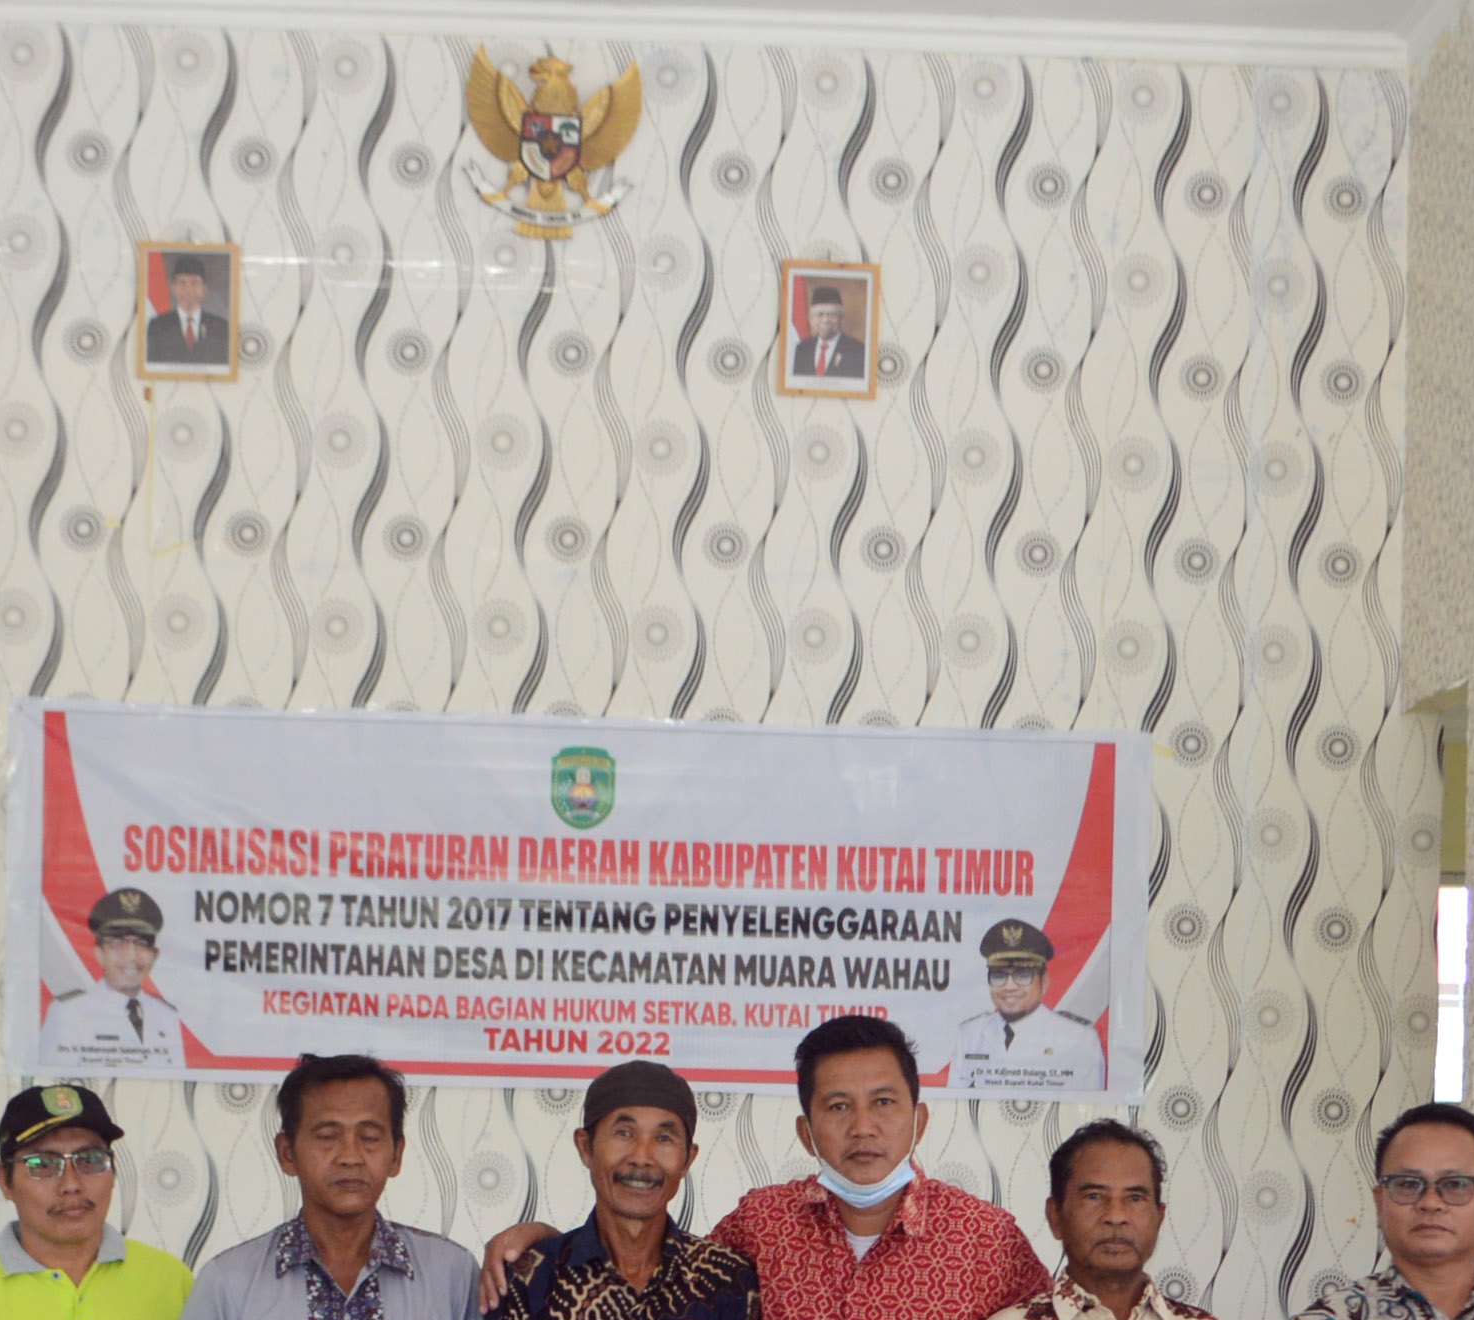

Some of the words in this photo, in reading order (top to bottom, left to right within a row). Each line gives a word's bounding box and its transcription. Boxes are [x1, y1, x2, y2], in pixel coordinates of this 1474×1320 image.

[124, 824, 320, 877] SOSIALISASI
[328, 831, 509, 881] PERATURAN
[518, 836, 640, 885] DAERAH
[649, 840, 828, 890] KABUPATEN
[836, 845, 927, 894] KUTAI
[934, 847, 1035, 897] TIMUR
[194, 889, 311, 926] NOMOR
[317, 893, 334, 927] 7
[340, 893, 439, 930] TAHUN
[446, 896, 510, 931] 2017
[519, 899, 657, 935] TENTANG
[664, 903, 962, 943] PENYELENGGARAAN
[204, 939, 426, 978] PEMERINTAHAN
[433, 946, 508, 981] DESA
[515, 948, 544, 981] DI
[551, 949, 727, 986] KECAMATAN
[734, 954, 835, 989] MUARA
[842, 956, 950, 992] WAHAU
[262, 989, 379, 1017] KEGIATAN
[386, 994, 450, 1020] PADA
[455, 995, 546, 1021] BAGIAN
[553, 997, 636, 1024] HUKUM
[643, 999, 737, 1026] SETKAB.
[744, 1002, 810, 1029] KUTAI
[483, 1027, 588, 1054] TAHUN
[596, 1030, 670, 1056] 2022
